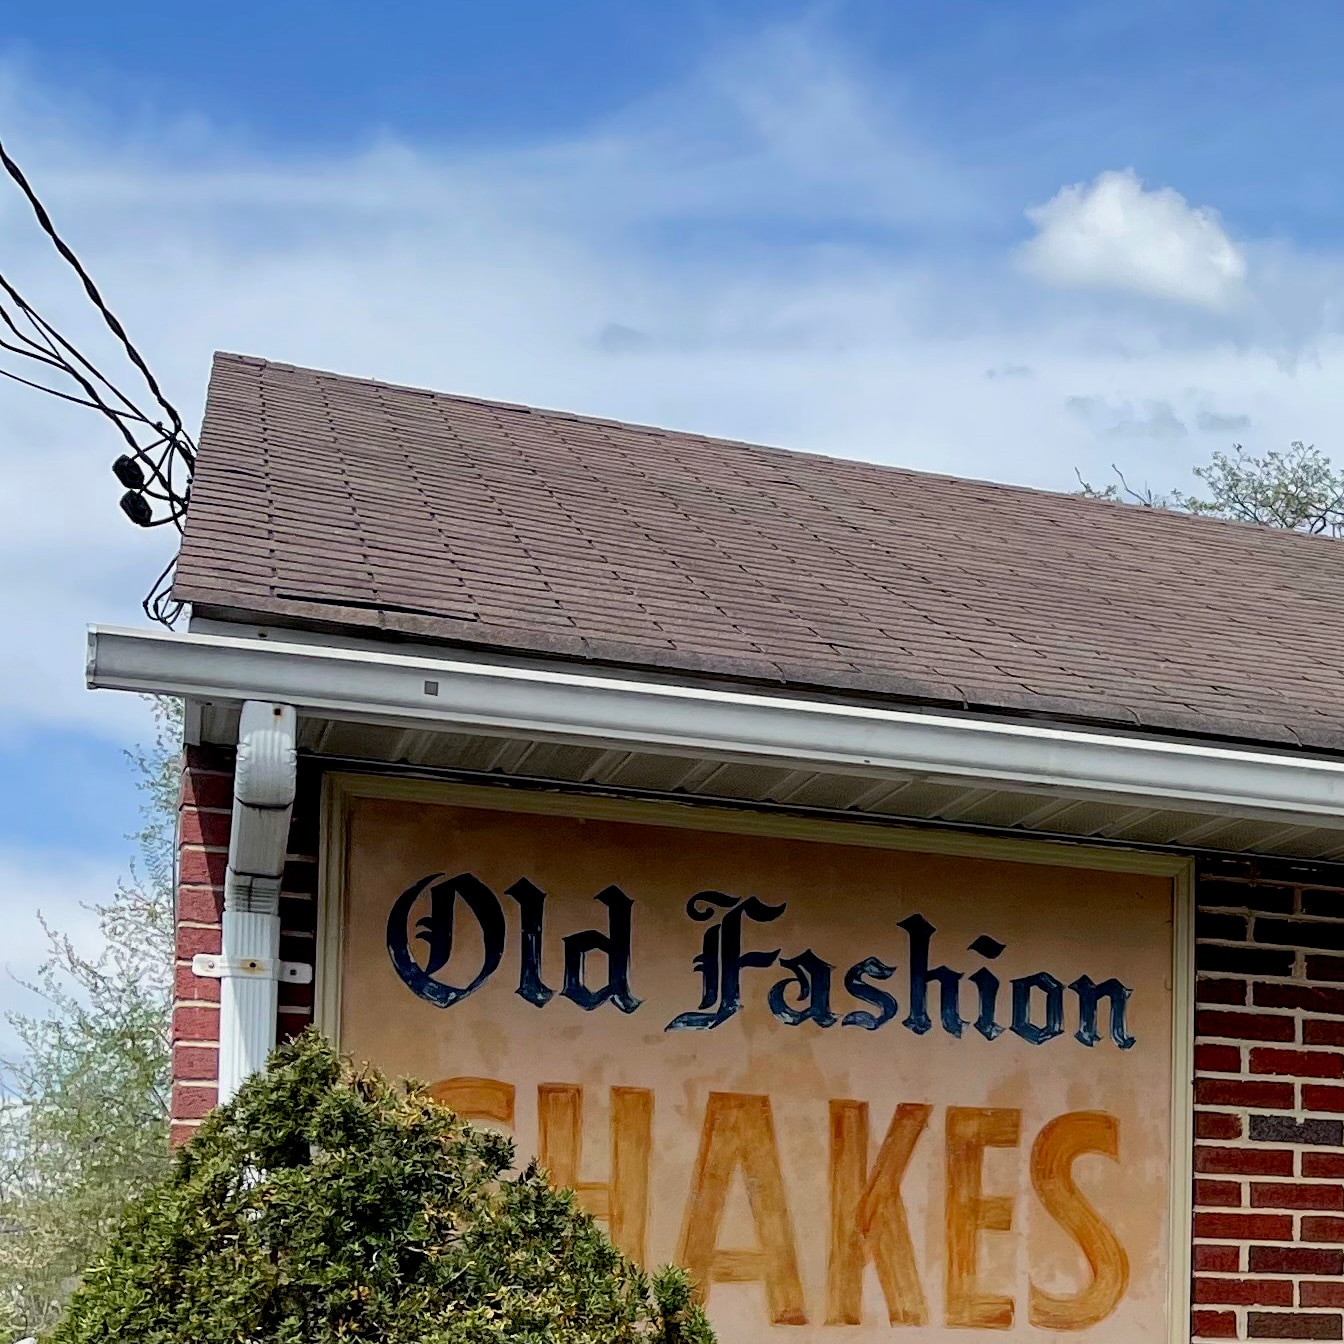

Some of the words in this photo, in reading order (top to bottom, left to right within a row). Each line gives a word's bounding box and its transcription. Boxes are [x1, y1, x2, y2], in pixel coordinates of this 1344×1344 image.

[386, 872, 642, 1015] Old
[664, 890, 1137, 1051] Fashion
[428, 1076, 1131, 1331] HAKES
